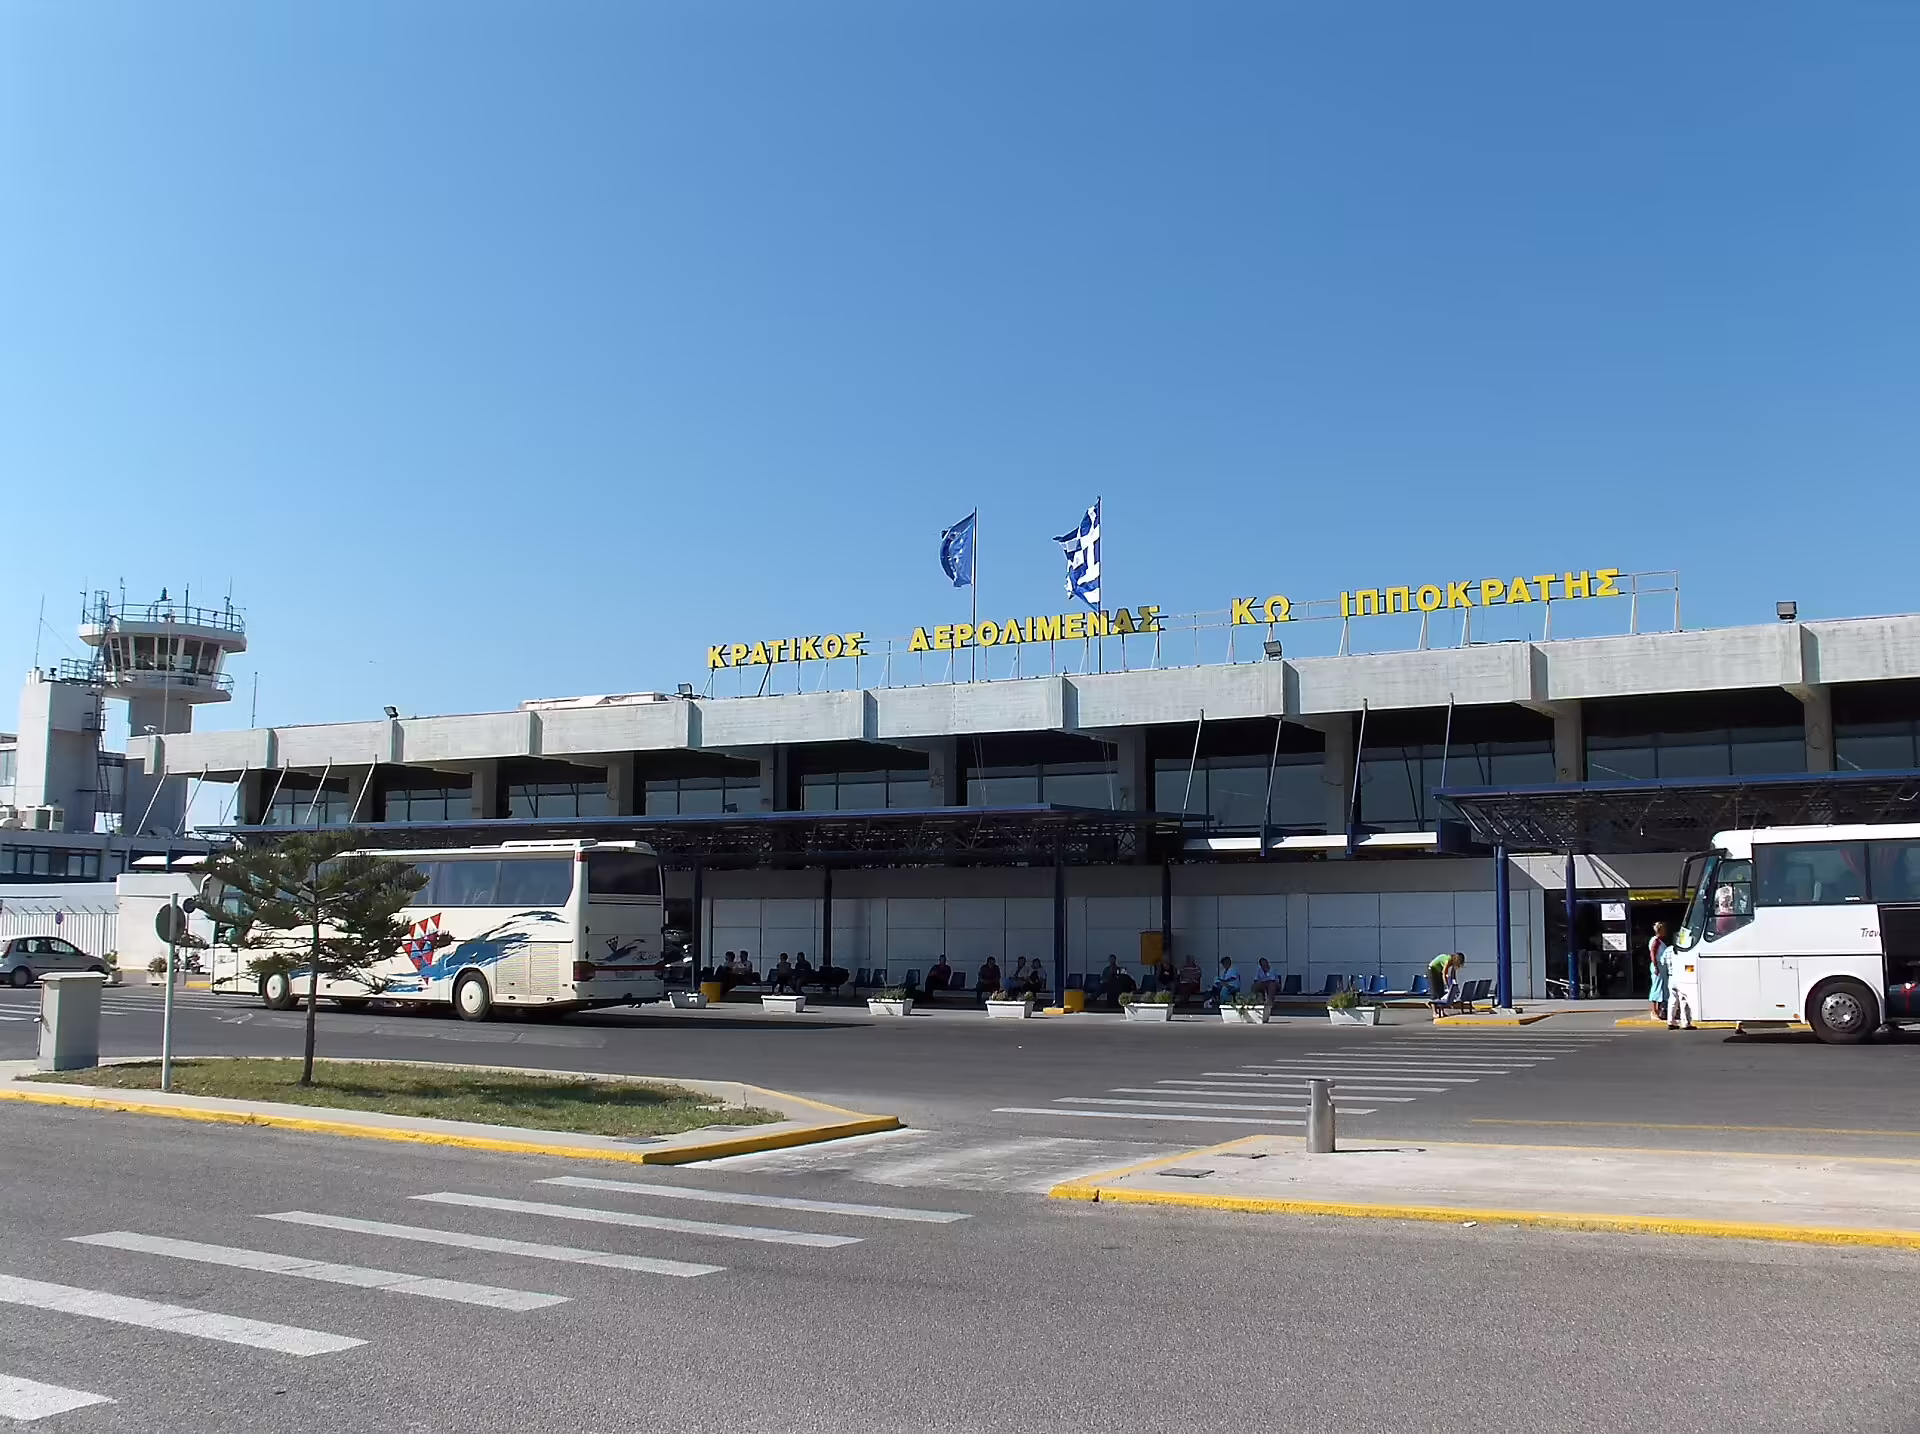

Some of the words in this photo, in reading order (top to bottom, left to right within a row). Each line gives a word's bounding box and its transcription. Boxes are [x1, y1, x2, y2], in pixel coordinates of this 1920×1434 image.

[707, 631, 866, 669] ΚΡΑΤΙΚΟΣ
[908, 605, 1161, 652] ΑΕΡΟΛΙΜΕΝΑΣ
[1231, 595, 1292, 625] ΚΩ
[1340, 568, 1620, 617] ΙΠΠΟΚΡΑΤΗΣ
[1860, 927, 1881, 938] Trav
